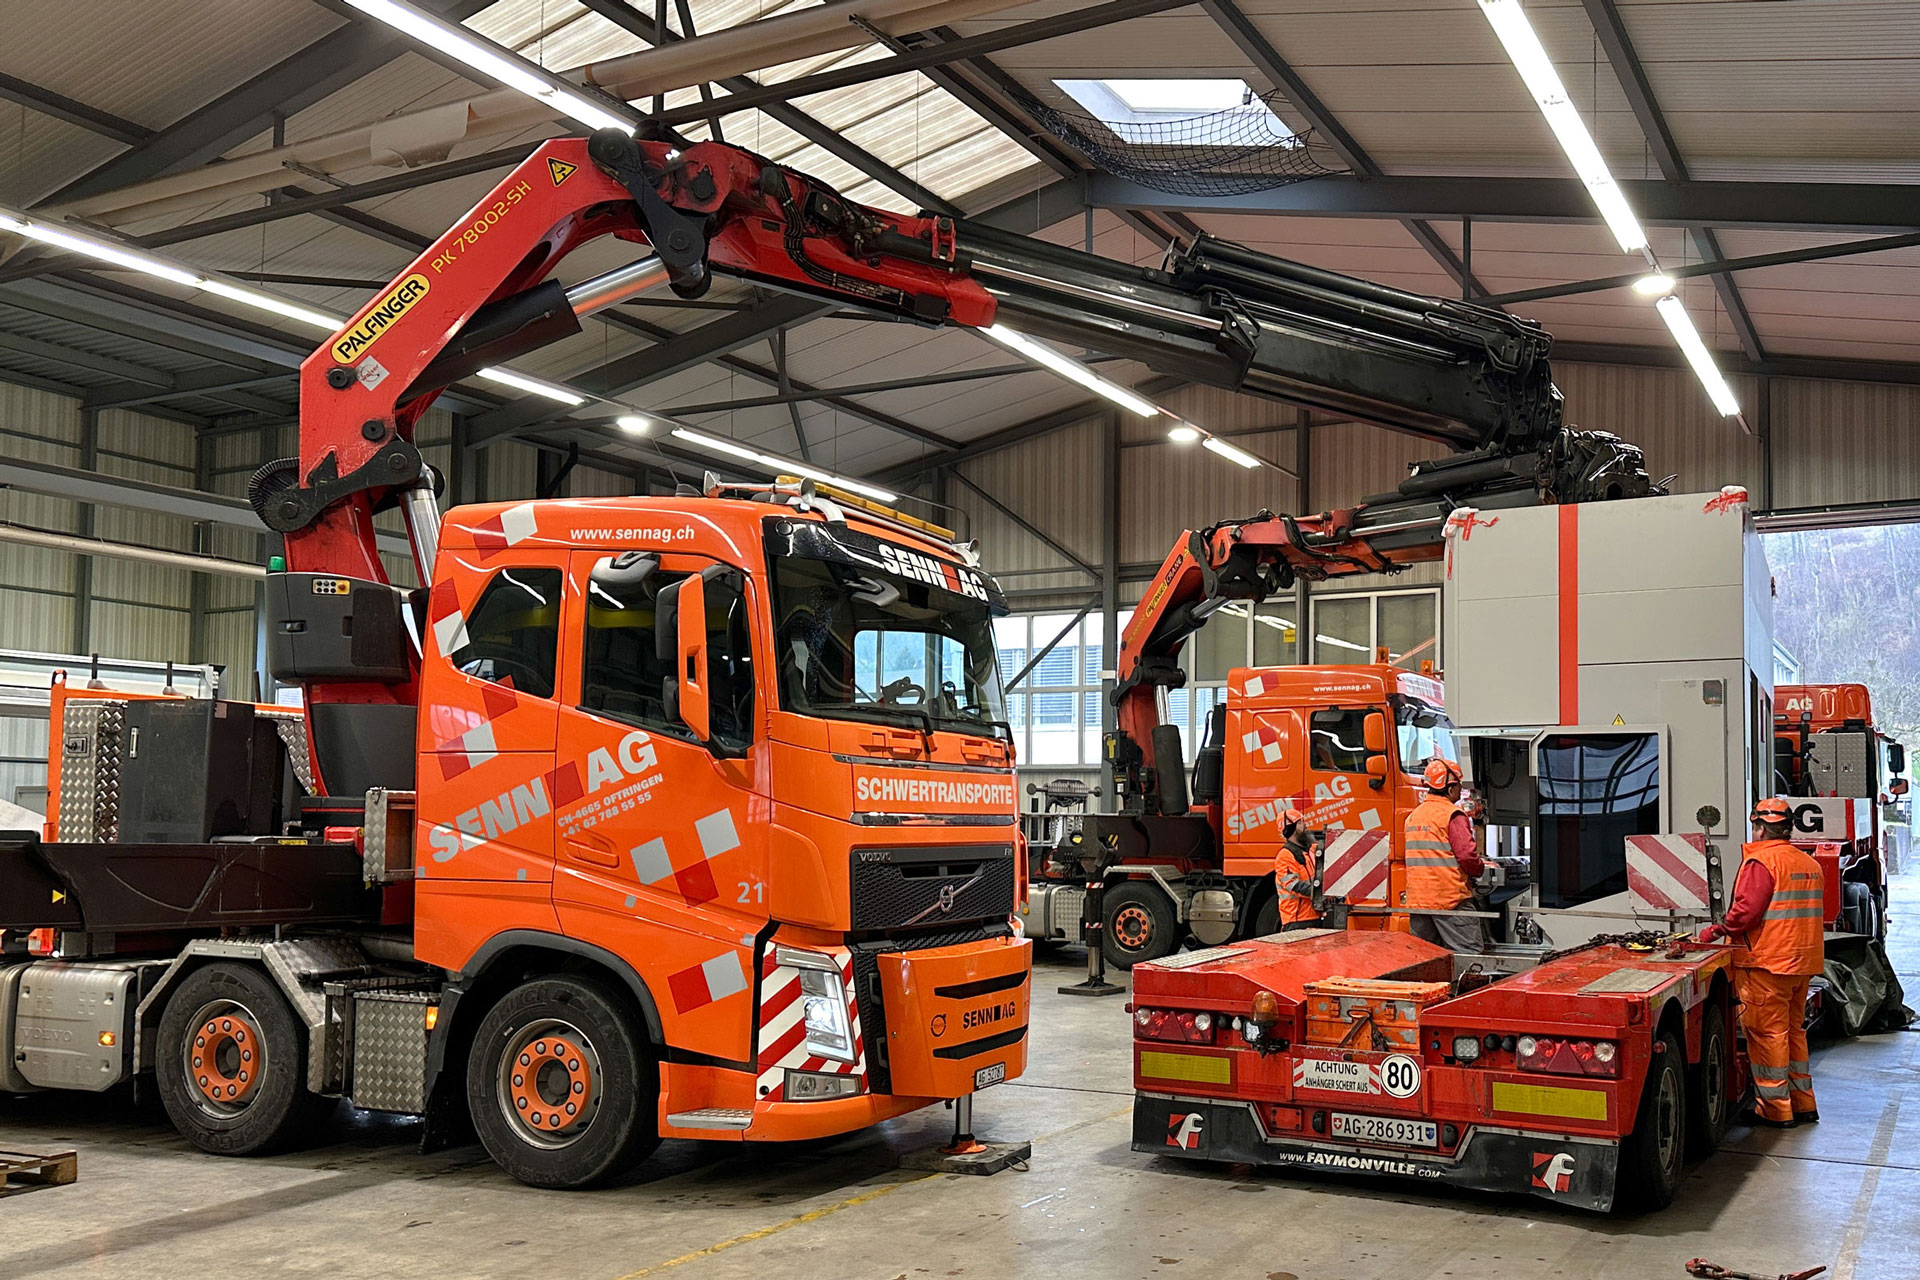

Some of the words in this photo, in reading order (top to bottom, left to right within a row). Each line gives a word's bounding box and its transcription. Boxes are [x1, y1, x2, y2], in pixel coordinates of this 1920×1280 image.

[431, 249, 457, 274] PK
[453, 180, 532, 254] 78002-SH
[336, 278, 426, 359] PALFINGER
[570, 525, 695, 543] www.sennag.ch
[878, 544, 949, 590] SENN
[958, 569, 989, 602] AG
[1786, 698, 1813, 711] AG
[429, 776, 550, 863] SENN
[587, 731, 658, 794] AG
[558, 800, 601, 827] CH-4665
[603, 773, 664, 806] OFTRINGEN
[857, 776, 1012, 805] SCHWERTRANSPORTE
[583, 816, 597, 829] 62
[598, 806, 619, 822] 788
[621, 799, 635, 811] 55
[637, 791, 652, 804] 55
[1227, 795, 1294, 835] SENN
[1314, 775, 1351, 804] AG
[736, 882, 763, 904] 21
[963, 1009, 992, 1029] SENN
[1002, 1001, 1015, 1019] AG
[20, 1026, 72, 1042] VOLVO
[1315, 1061, 1358, 1075] ACHTUNG
[1387, 1062, 1413, 1090] 80
[1305, 1077, 1335, 1090] ANHÄNGER
[1335, 1080, 1356, 1091] SCHERT
[1357, 1082, 1368, 1092] AUS
